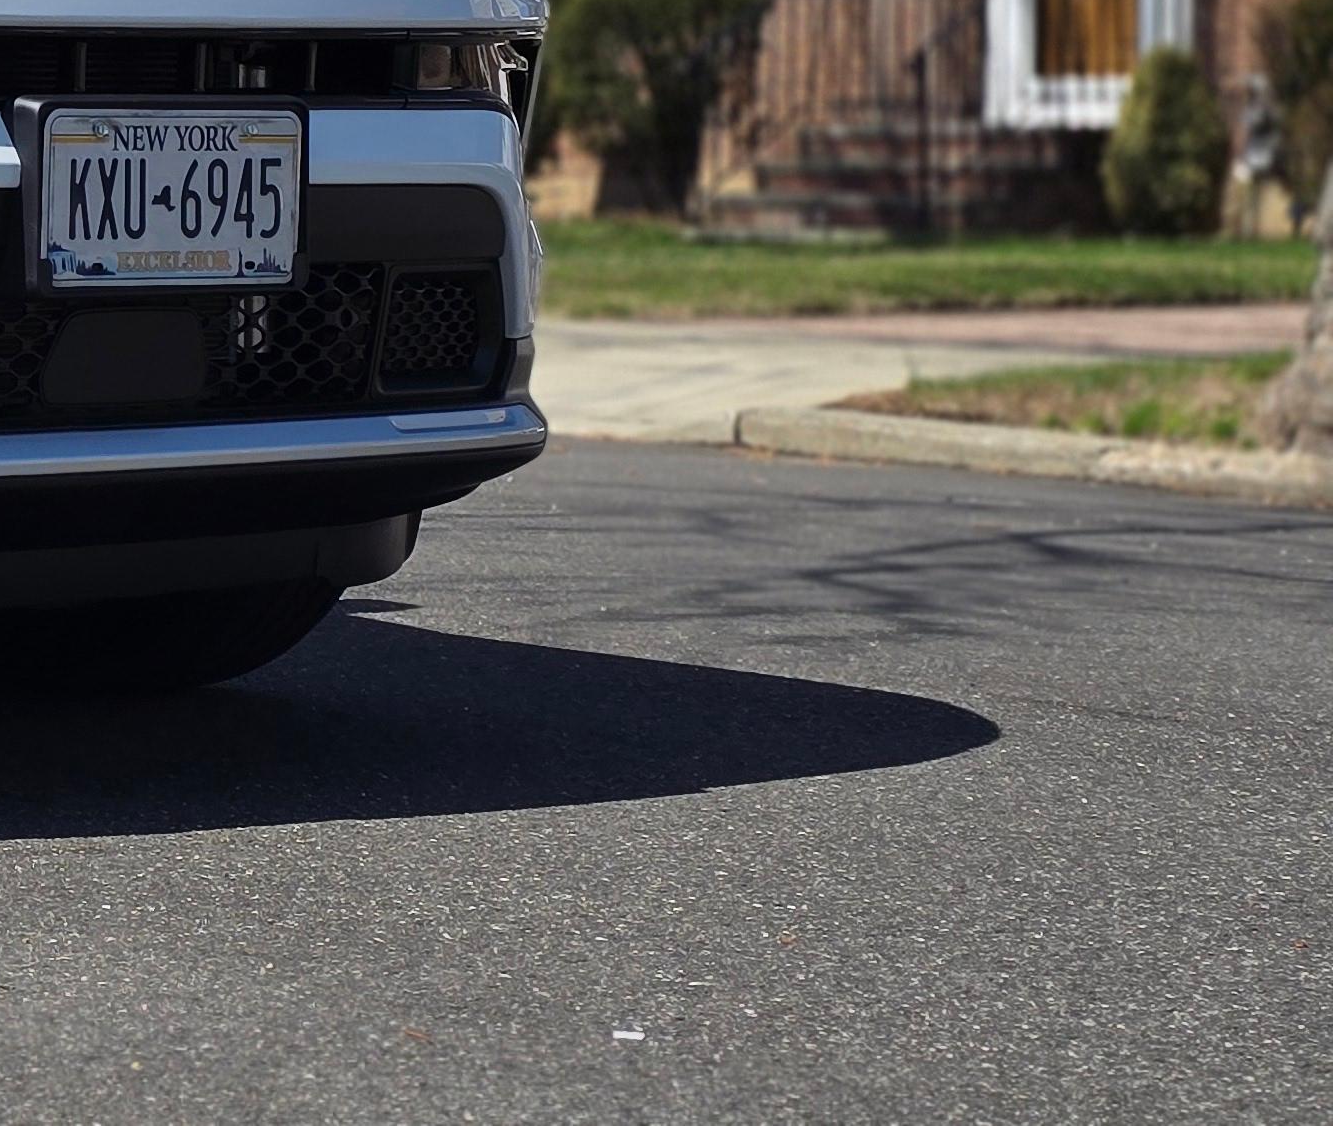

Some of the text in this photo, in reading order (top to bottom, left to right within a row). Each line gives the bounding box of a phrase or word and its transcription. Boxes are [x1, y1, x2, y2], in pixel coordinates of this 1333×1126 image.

[112, 125, 238, 152] NEW YORK
[68, 157, 282, 240] KXU 6945
[115, 249, 233, 273] EXCELSIOR
